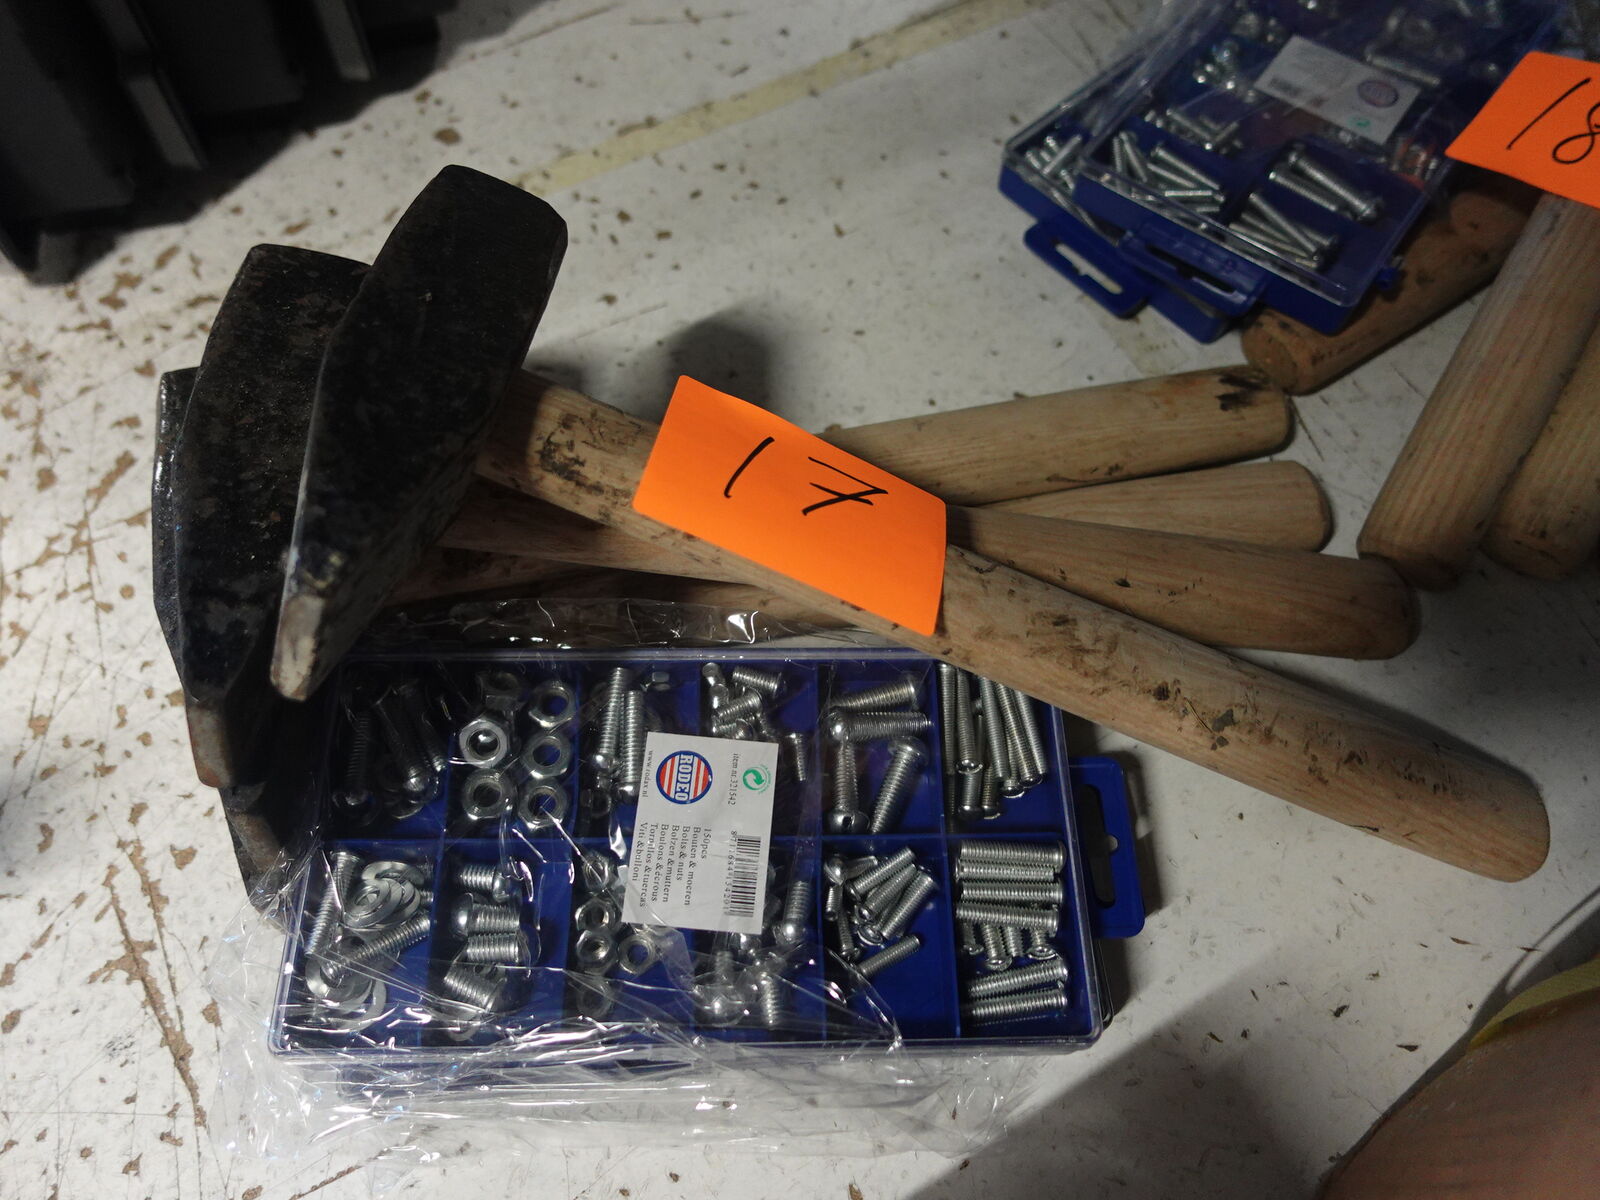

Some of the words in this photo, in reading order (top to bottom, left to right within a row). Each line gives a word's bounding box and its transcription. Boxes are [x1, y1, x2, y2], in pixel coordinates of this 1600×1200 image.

[722, 436, 889, 516] 17
[731, 753, 740, 768] item
[675, 754, 693, 801] RODEO
[638, 822, 647, 838] Viti
[657, 824, 669, 860] Boulons
[669, 825, 679, 856] Bolzen
[680, 826, 690, 849] Bolts
[690, 827, 701, 858] Bouten
[701, 828, 712, 859] 150pcs
[679, 851, 686, 859] &
[676, 862, 685, 881] nuts
[684, 872, 694, 906] moeren
